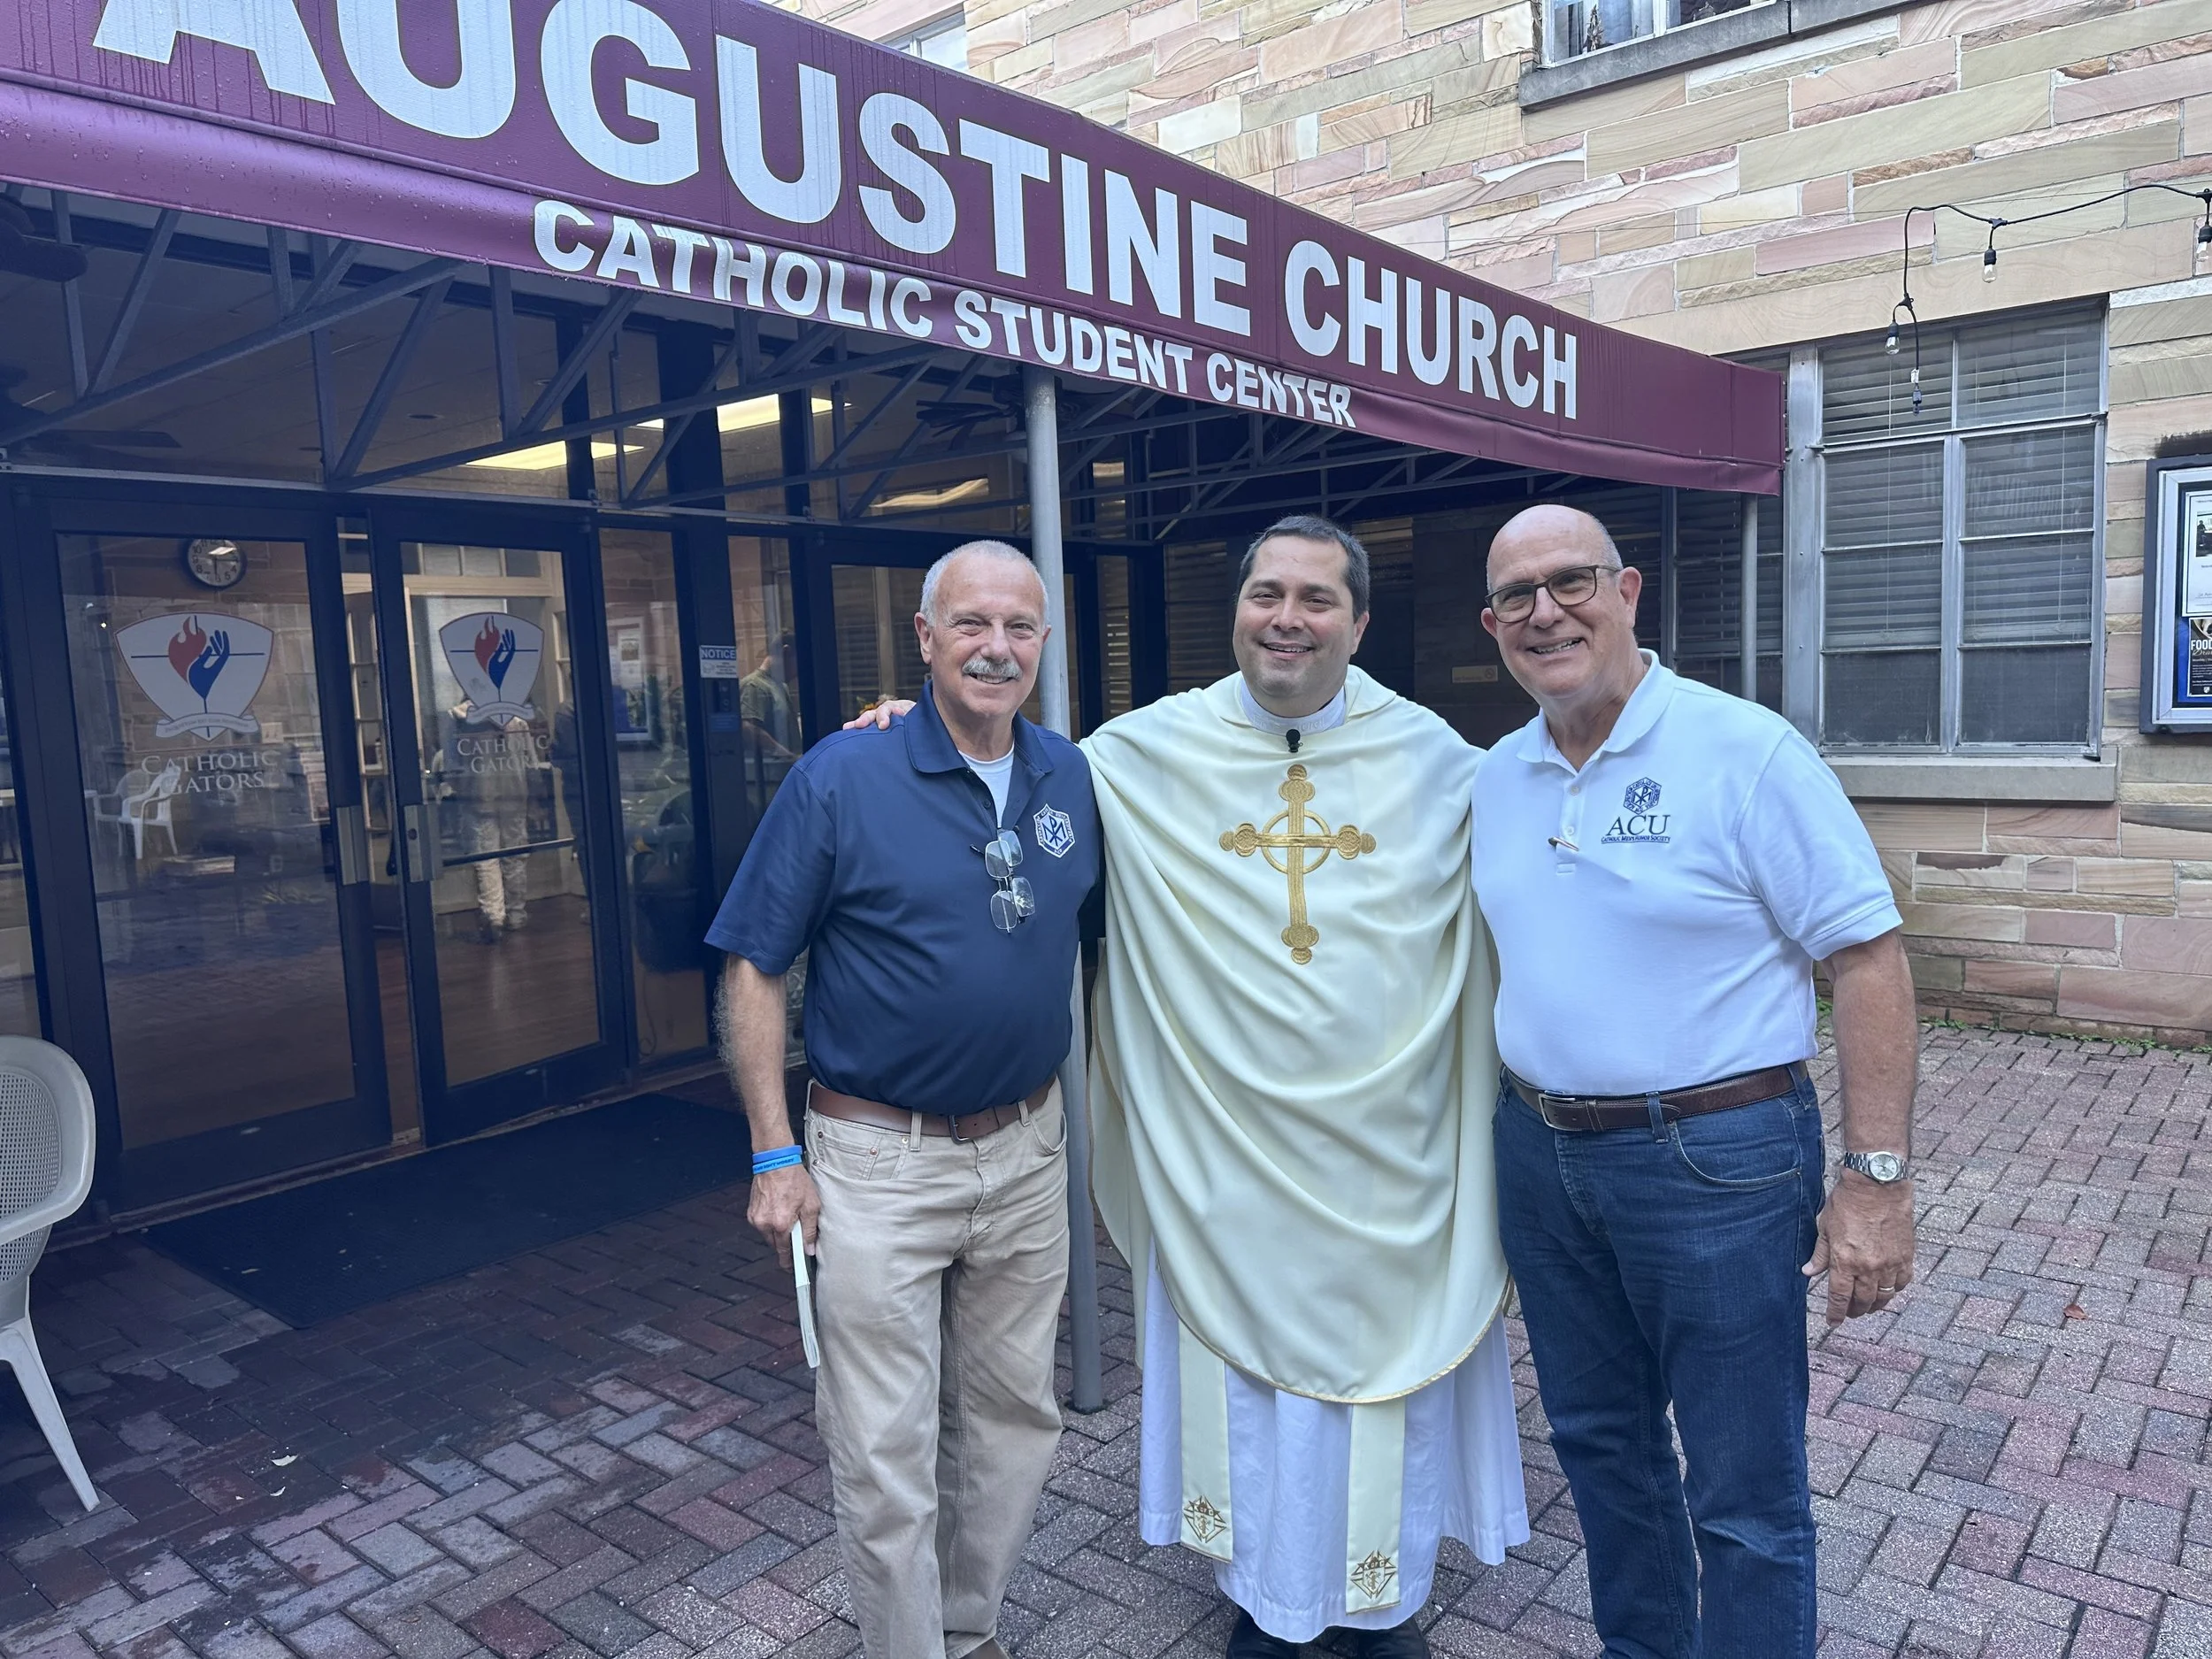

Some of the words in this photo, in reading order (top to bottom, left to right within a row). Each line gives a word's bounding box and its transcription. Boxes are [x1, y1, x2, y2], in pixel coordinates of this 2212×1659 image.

[534, 200, 934, 338] CATHOLIC
[954, 290, 1193, 395] STUDENT
[1207, 352, 1356, 428] CENTER
[1284, 239, 1578, 419] CHURCH
[701, 649, 736, 659] NOTICE
[142, 750, 280, 775] CATHOLIC
[1605, 814, 1671, 836] ACU
